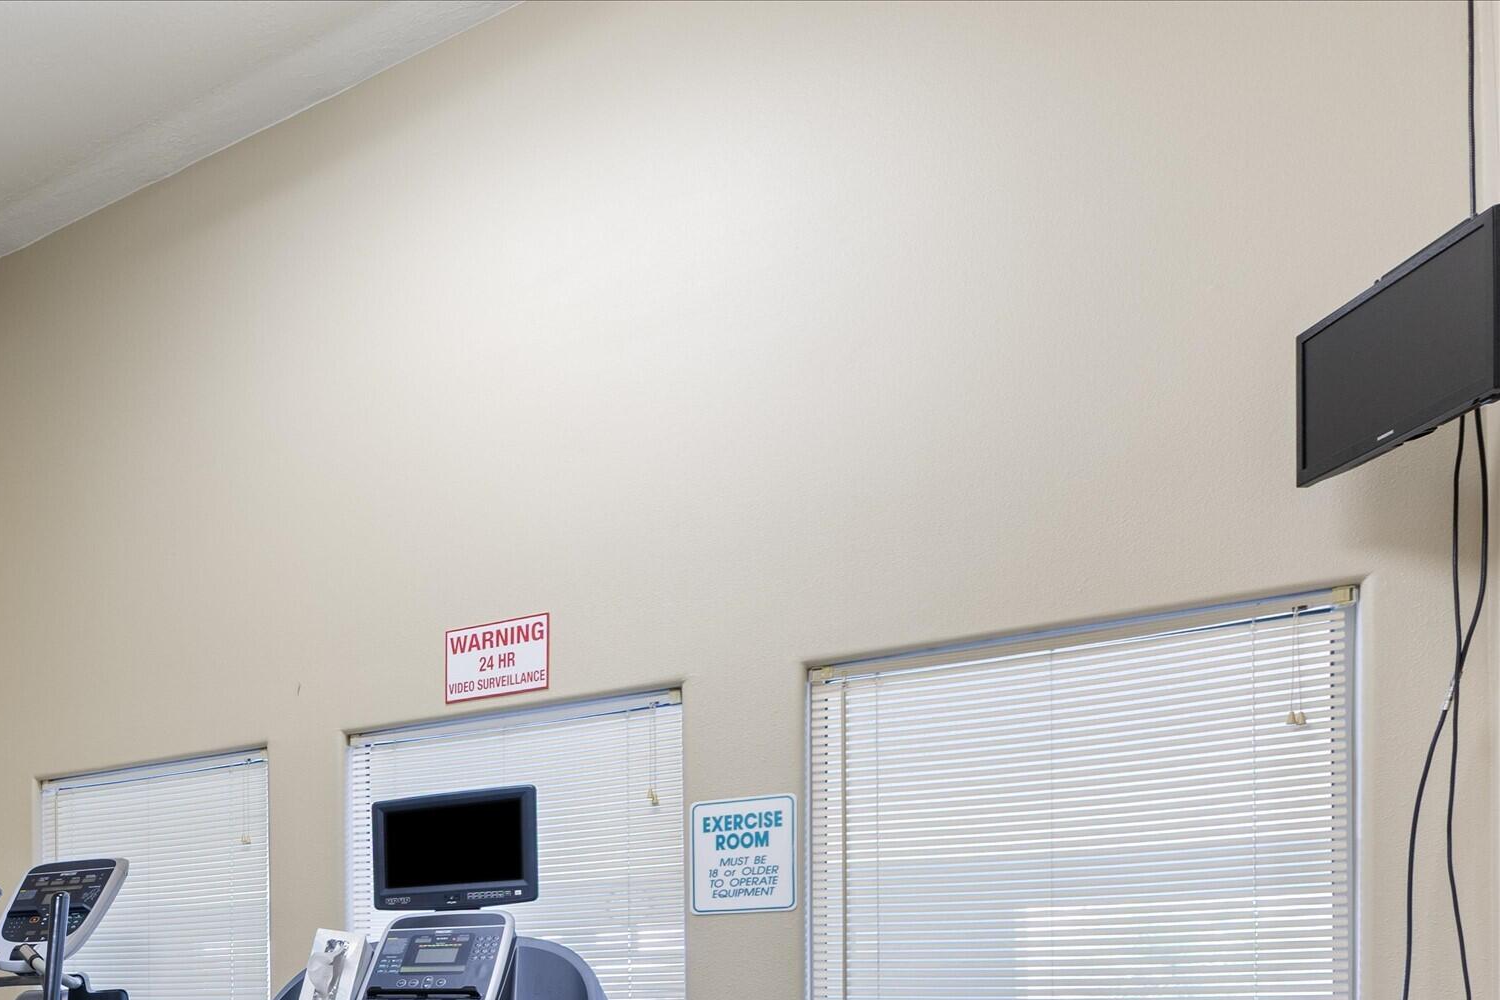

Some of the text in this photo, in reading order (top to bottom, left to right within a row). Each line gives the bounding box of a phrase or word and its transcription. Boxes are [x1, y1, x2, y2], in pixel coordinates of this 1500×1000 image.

[450, 621, 544, 655] WARNING
[479, 652, 515, 672] 24 HR
[449, 669, 546, 695] VIDEO SURVEILLANCE
[702, 810, 782, 833] EXERCISE
[715, 831, 769, 851] ROOM
[719, 855, 767, 867] MUST BE
[708, 869, 718, 878] 18
[741, 865, 779, 876] OLDER
[709, 876, 778, 888] TO OPERATE
[711, 887, 775, 899] EQUIPMENT
